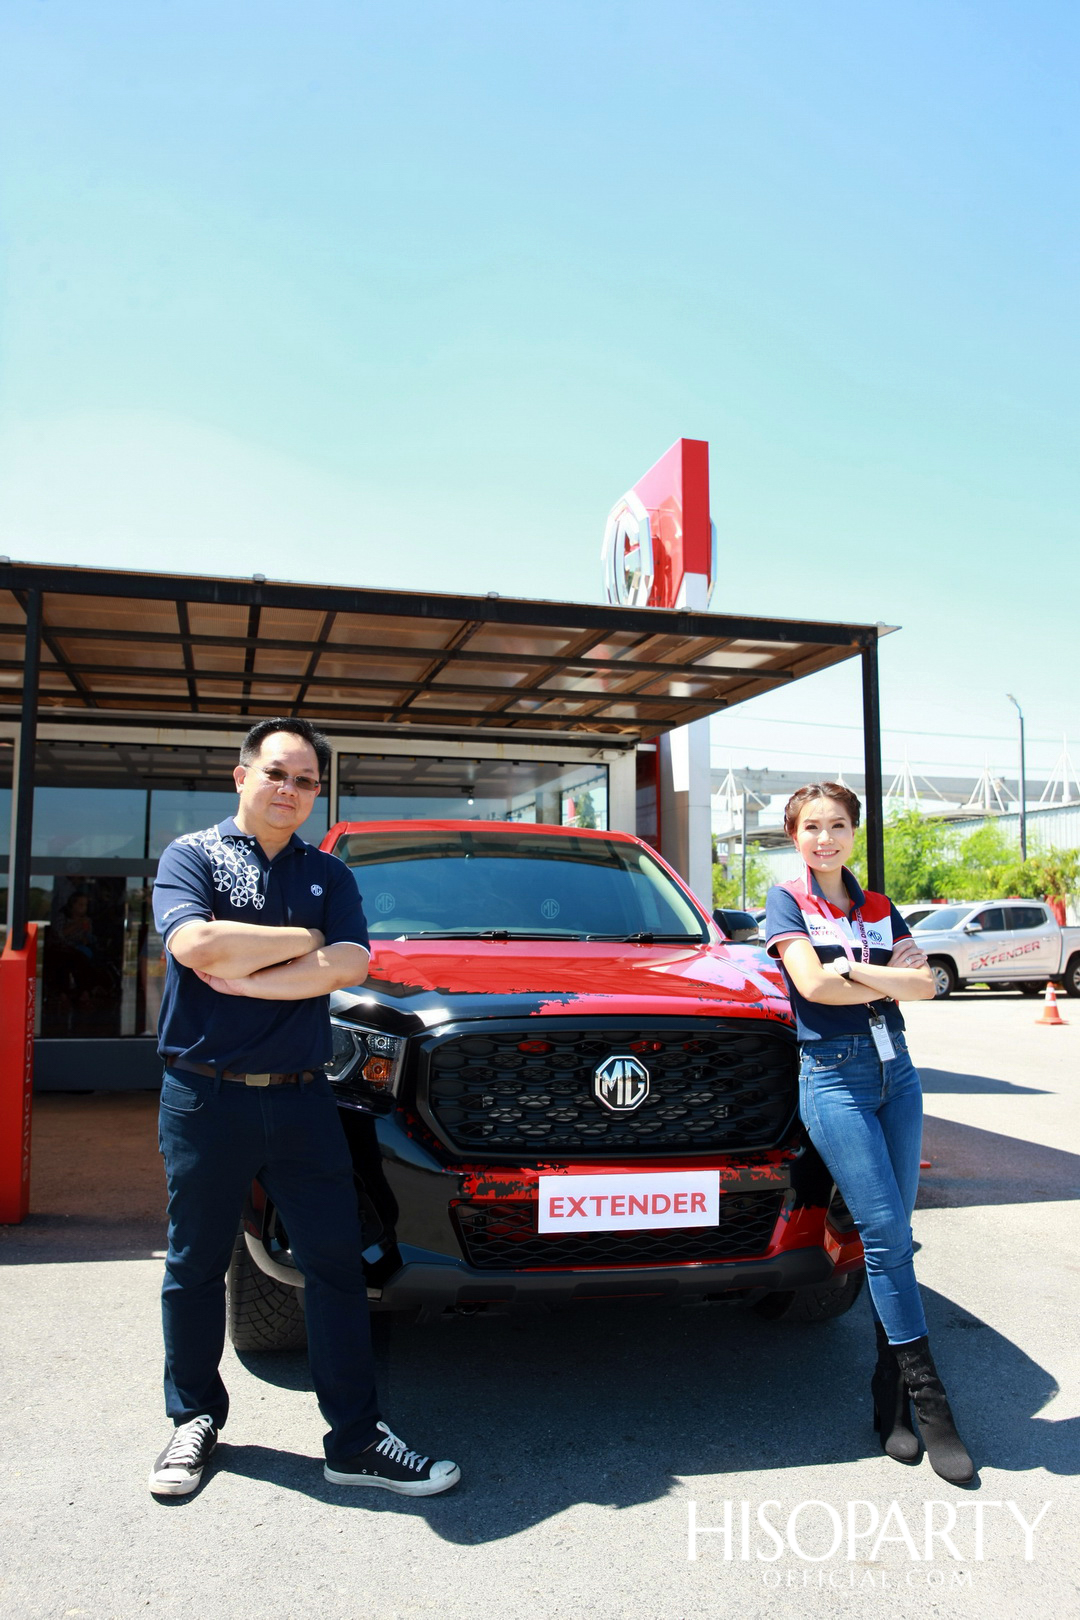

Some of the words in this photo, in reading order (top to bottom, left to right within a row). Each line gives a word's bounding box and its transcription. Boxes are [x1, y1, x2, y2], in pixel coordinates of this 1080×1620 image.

[377, 894, 393, 912] MG
[542, 900, 558, 917] MG
[971, 941, 1040, 971] EXTENDER
[26, 976, 34, 1083] PASSION
[601, 1060, 646, 1106] MG
[23, 1092, 31, 1182] DRIVES
[549, 1192, 707, 1218] EXTENDER
